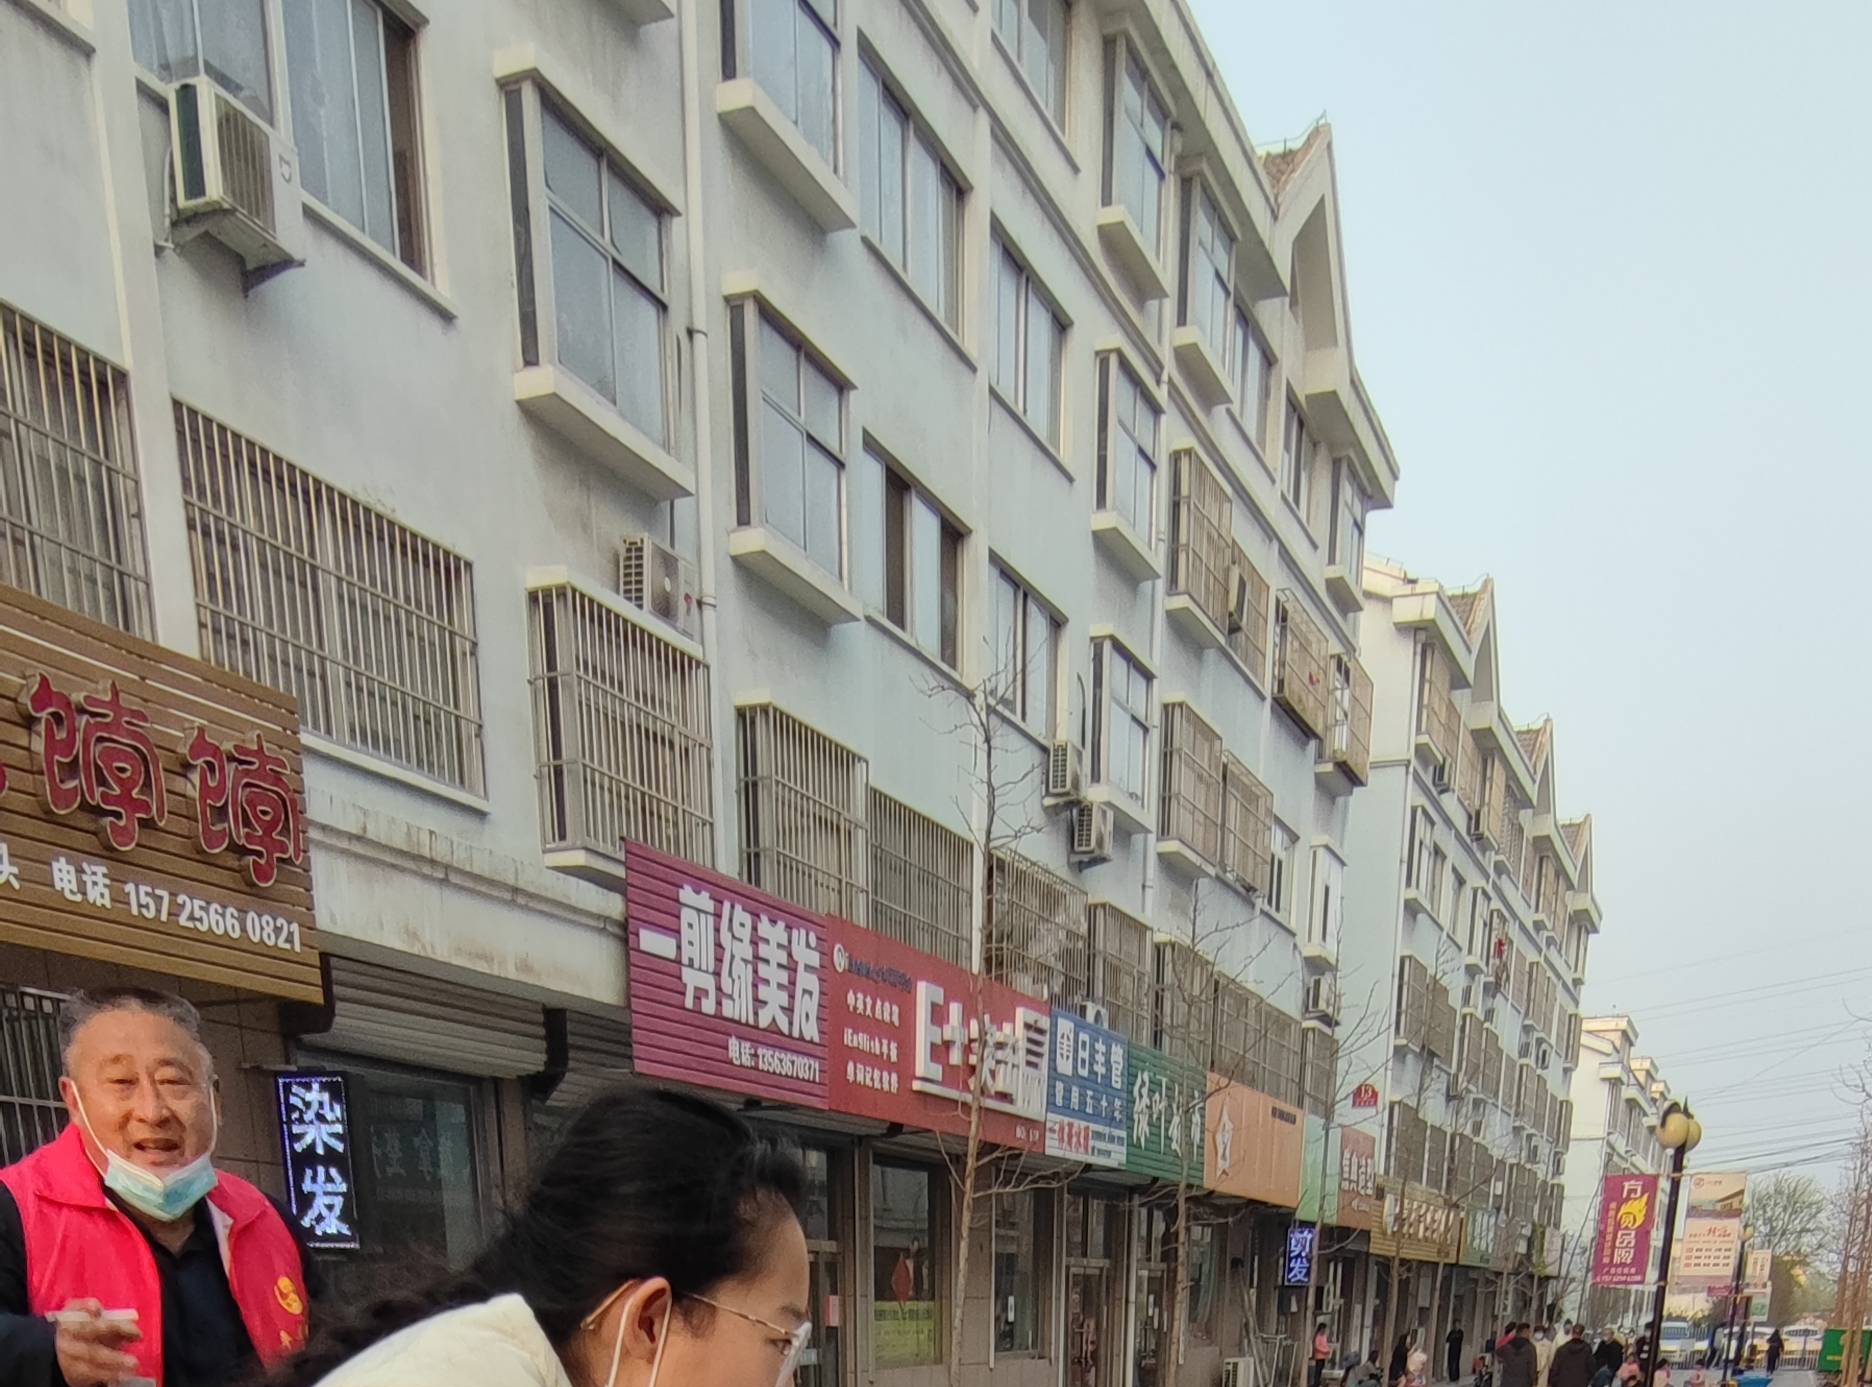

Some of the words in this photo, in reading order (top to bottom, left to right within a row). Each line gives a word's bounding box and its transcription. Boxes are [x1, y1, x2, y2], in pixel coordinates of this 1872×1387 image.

[51, 856, 112, 909] 电话
[124, 881, 170, 922] 157
[176, 893, 242, 940] 2566
[246, 910, 302, 953] 0821
[639, 884, 821, 1044] 一剪缘美发
[757, 1046, 820, 1083] 13563670371
[290, 1083, 352, 1238] 染发
